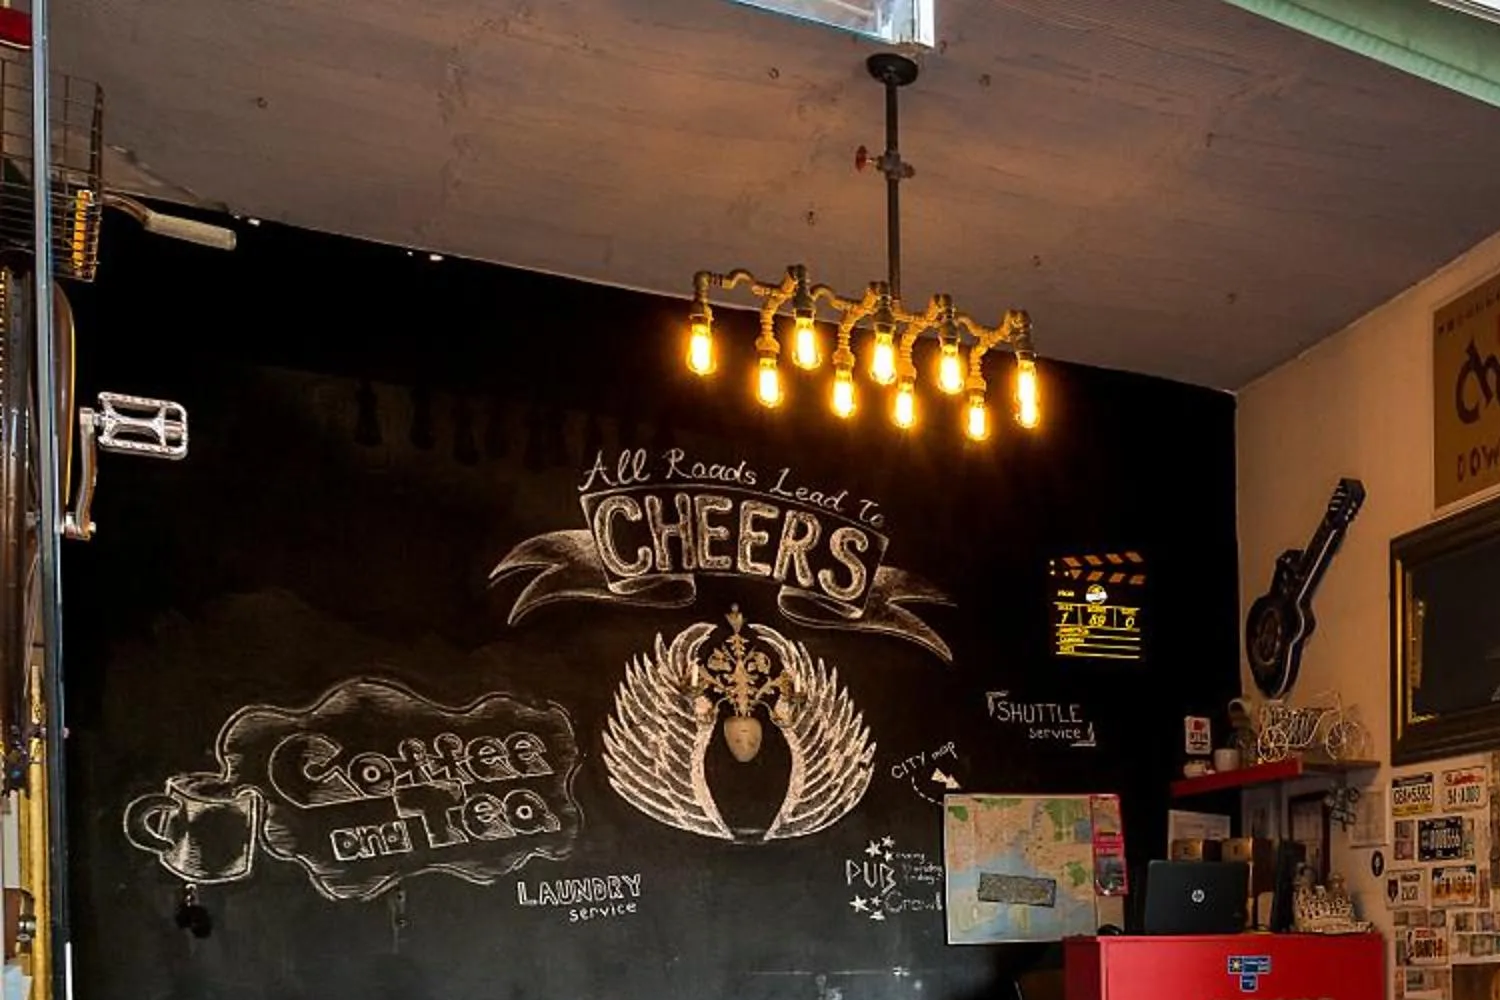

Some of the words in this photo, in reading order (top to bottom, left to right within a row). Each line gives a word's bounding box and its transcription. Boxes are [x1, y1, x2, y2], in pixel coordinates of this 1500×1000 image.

[577, 448, 650, 491] All
[663, 448, 757, 485] Roads
[769, 467, 848, 512] Lead
[859, 499, 885, 527] To
[594, 492, 869, 601] CHEERS
[997, 701, 1083, 722] SHUTTLE
[1029, 726, 1081, 739] service
[268, 732, 554, 808] Coffee
[891, 751, 925, 779] CITY
[394, 779, 561, 848] Tea
[517, 874, 642, 906] LAUNDRY
[846, 859, 896, 896] PUB
[569, 902, 638, 922] service
